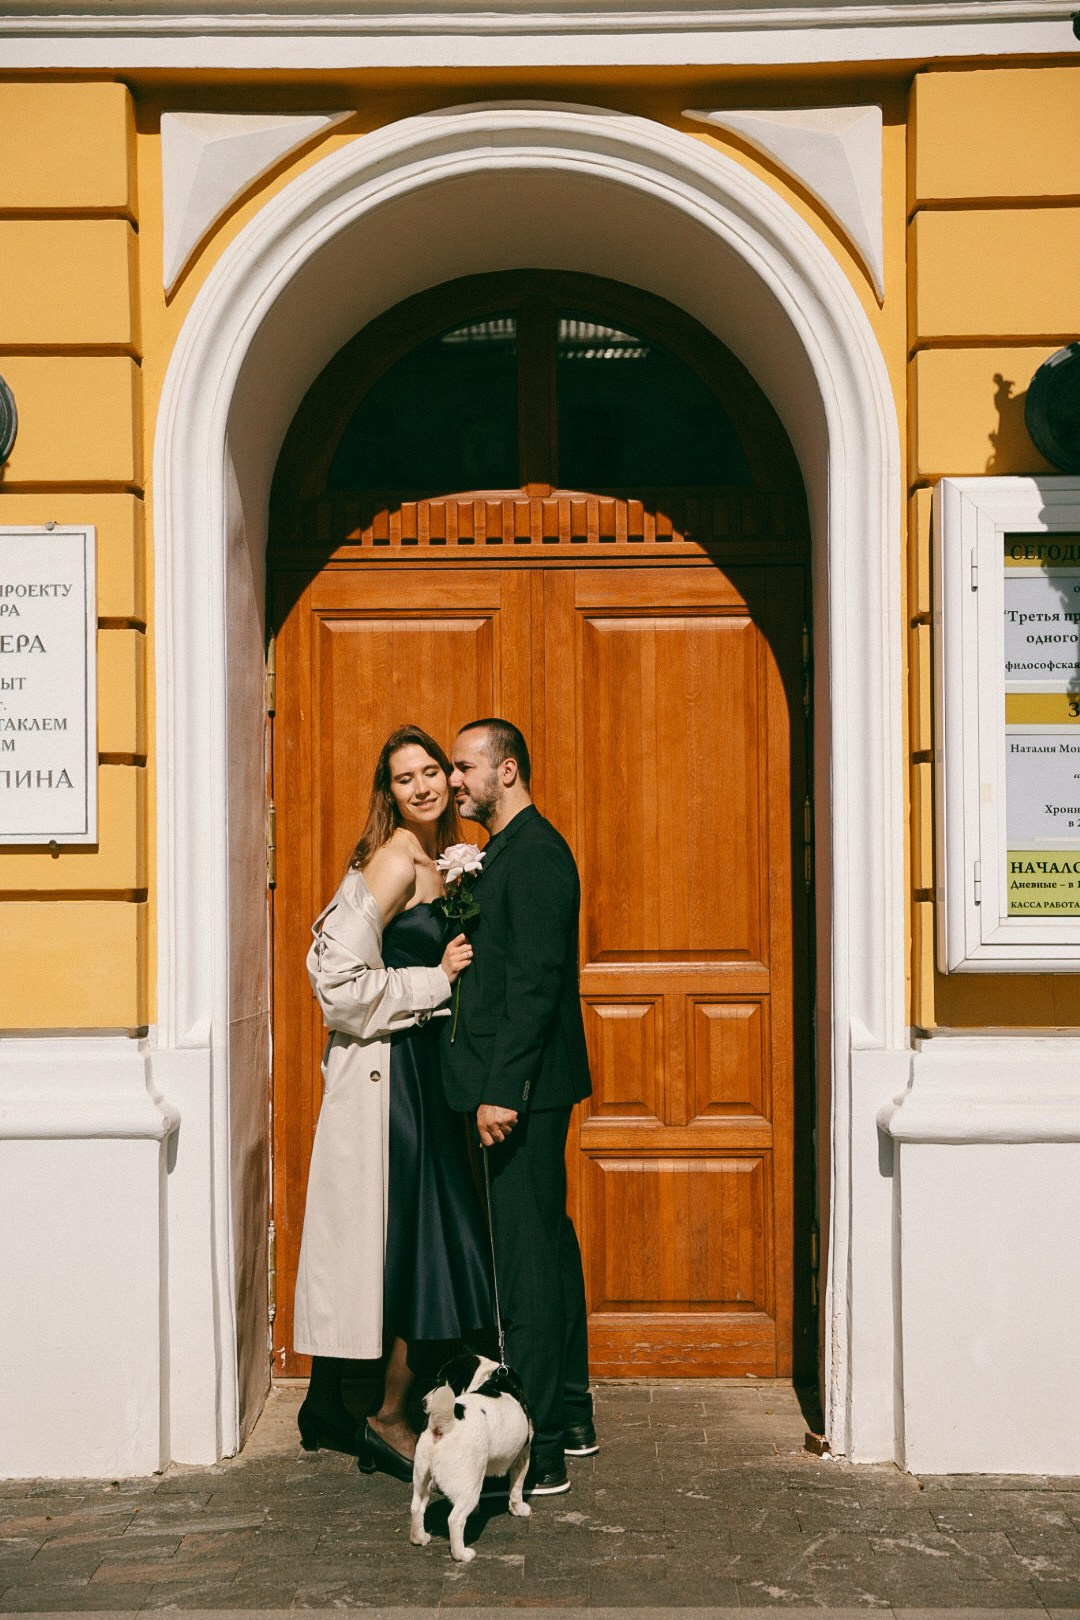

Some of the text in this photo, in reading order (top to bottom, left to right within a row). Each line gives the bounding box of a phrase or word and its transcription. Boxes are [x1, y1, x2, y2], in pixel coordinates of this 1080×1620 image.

[1010, 544, 1080, 563] СЕГОД
[1026, 635, 1078, 645] одного
[1005, 660, 1080, 672] философская
[1010, 744, 1056, 753] Наталия
[1010, 880, 1057, 890] Дневные
